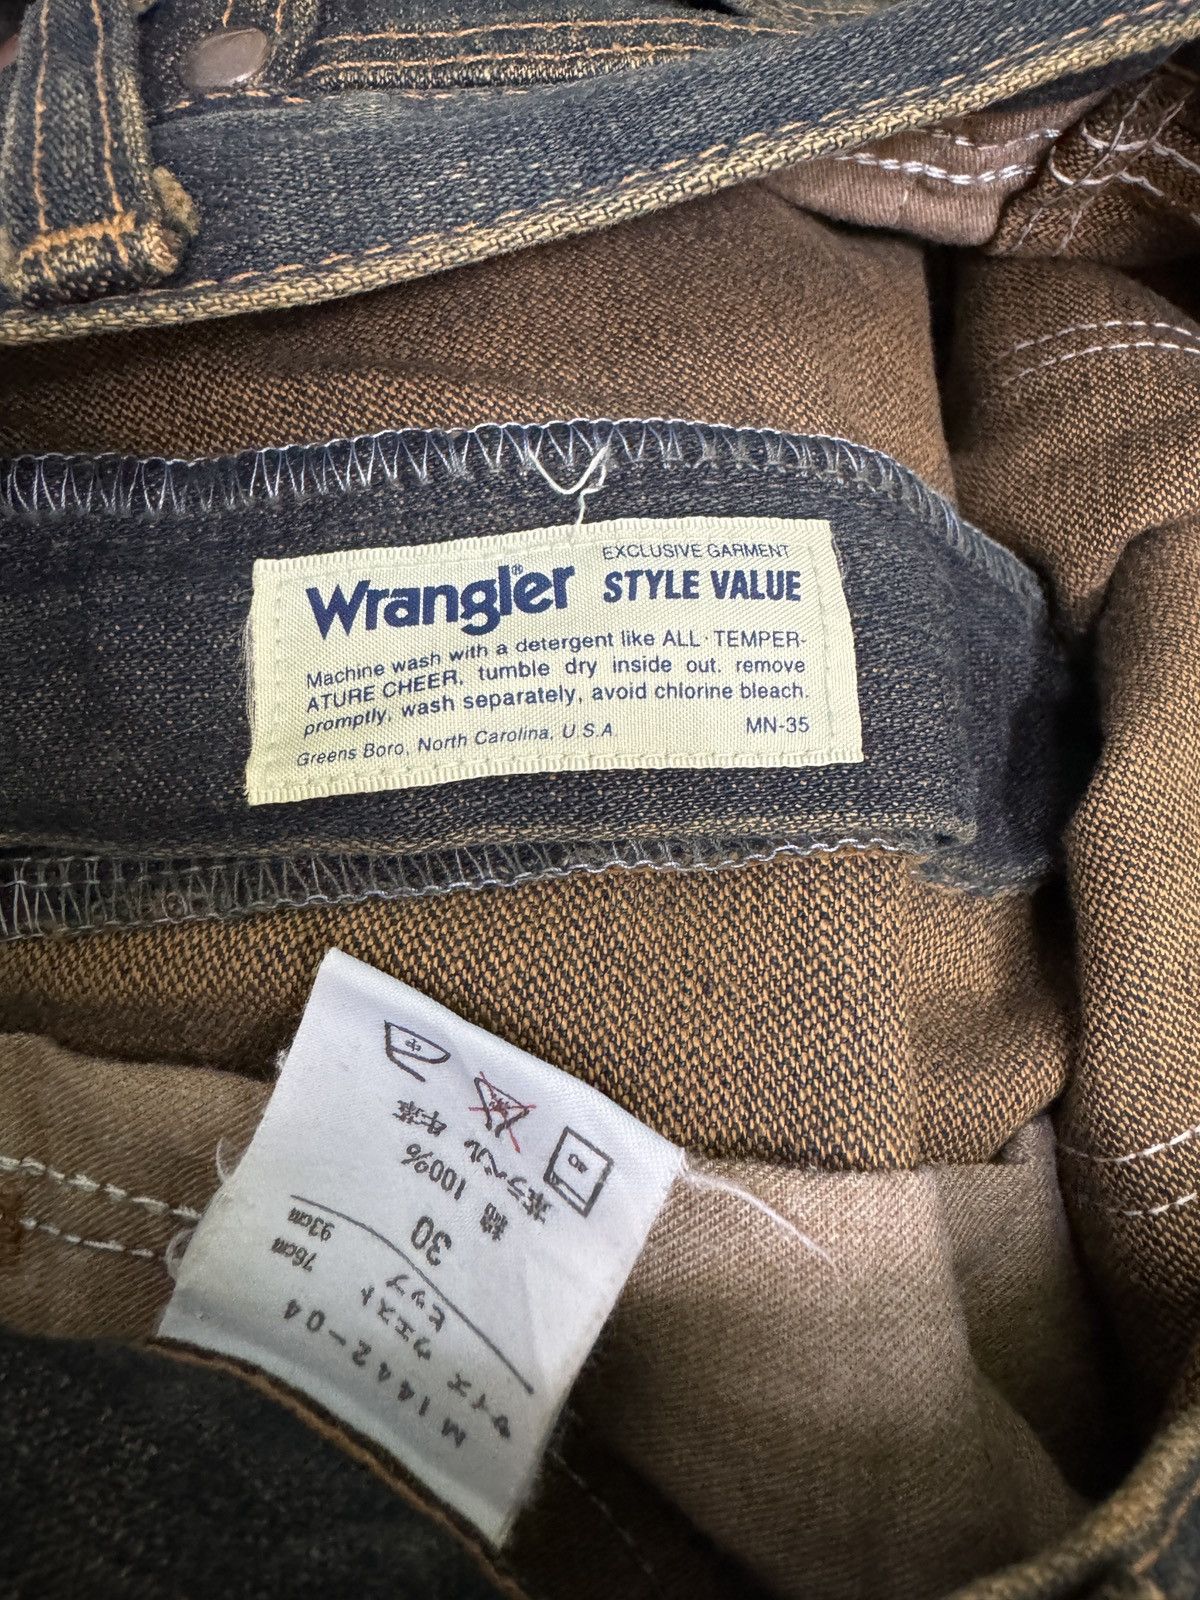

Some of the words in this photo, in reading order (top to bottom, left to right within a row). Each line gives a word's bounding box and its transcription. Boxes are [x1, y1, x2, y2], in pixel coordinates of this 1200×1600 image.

[603, 543, 702, 560] EXCLUSIVE
[707, 543, 789, 559] GARMENT
[603, 569, 700, 602] STYLE
[711, 570, 801, 601] VALUE
[306, 685, 375, 713] ATURE
[383, 670, 464, 698] CHEER,
[479, 659, 550, 681] tumble
[565, 657, 597, 678] dry
[613, 656, 672, 673] inside
[736, 659, 806, 673] remove
[307, 663, 385, 689] Machine
[392, 652, 441, 674] wash
[450, 643, 488, 662] with
[496, 643, 508, 655] a
[515, 631, 613, 654] detergent
[621, 630, 655, 647] like
[304, 708, 391, 739] promptly,
[402, 695, 455, 717] wash
[463, 684, 582, 712] separately,
[591, 682, 647, 700] avoid
[655, 681, 733, 699] chlorine
[741, 682, 809, 699] bleach.
[746, 716, 810, 734] MN-35
[297, 747, 357, 767] Greens
[363, 742, 410, 760] Boro,
[418, 733, 467, 752] North
[475, 727, 553, 745] Carolina,
[401, 1143, 467, 1201] 100%
[288, 1206, 335, 1242] 93cm
[411, 1215, 452, 1267] 30
[271, 1236, 318, 1272] 76cm
[361, 1285, 431, 1361] ウエスト
[386, 1274, 446, 1333] ヒップ
[447, 1372, 511, 1439] サイズ
